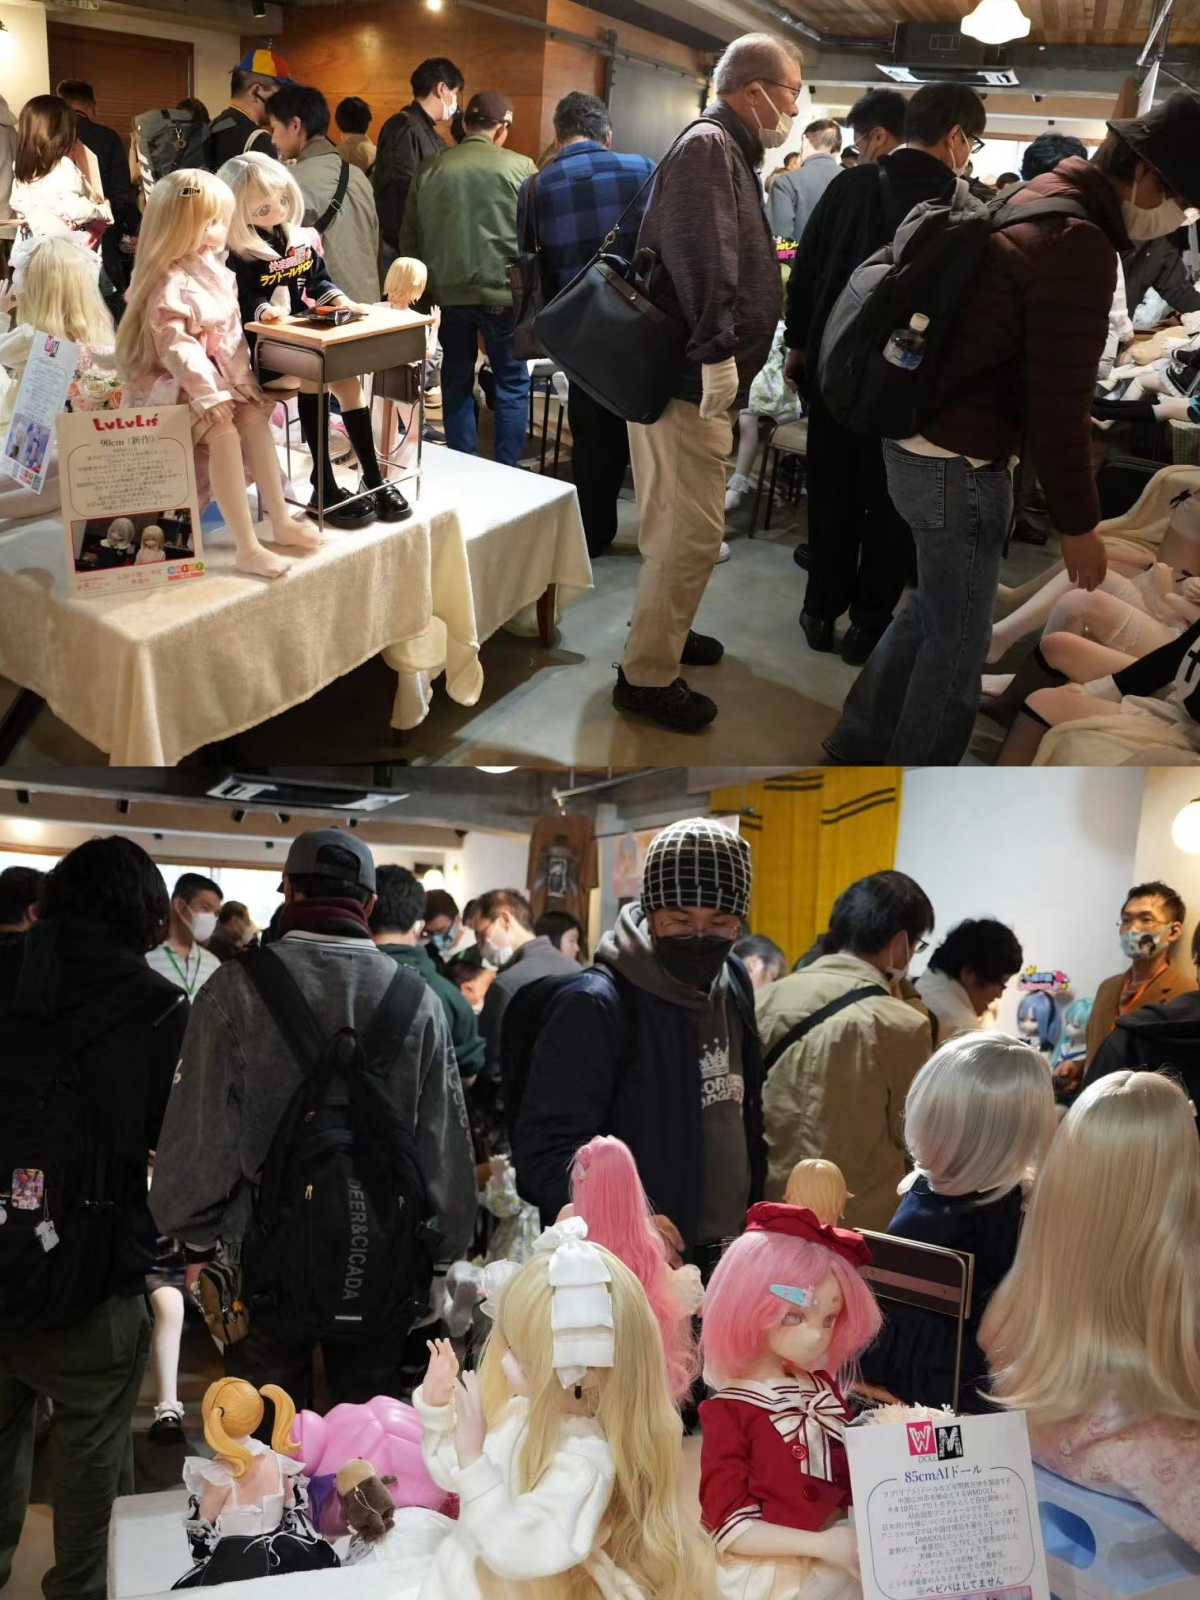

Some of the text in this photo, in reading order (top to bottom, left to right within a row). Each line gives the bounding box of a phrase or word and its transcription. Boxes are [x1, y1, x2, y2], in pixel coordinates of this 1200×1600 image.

[342, 1177, 369, 1300] DEER&CICADA
[904, 1465, 983, 1484] 85cmAIドール
